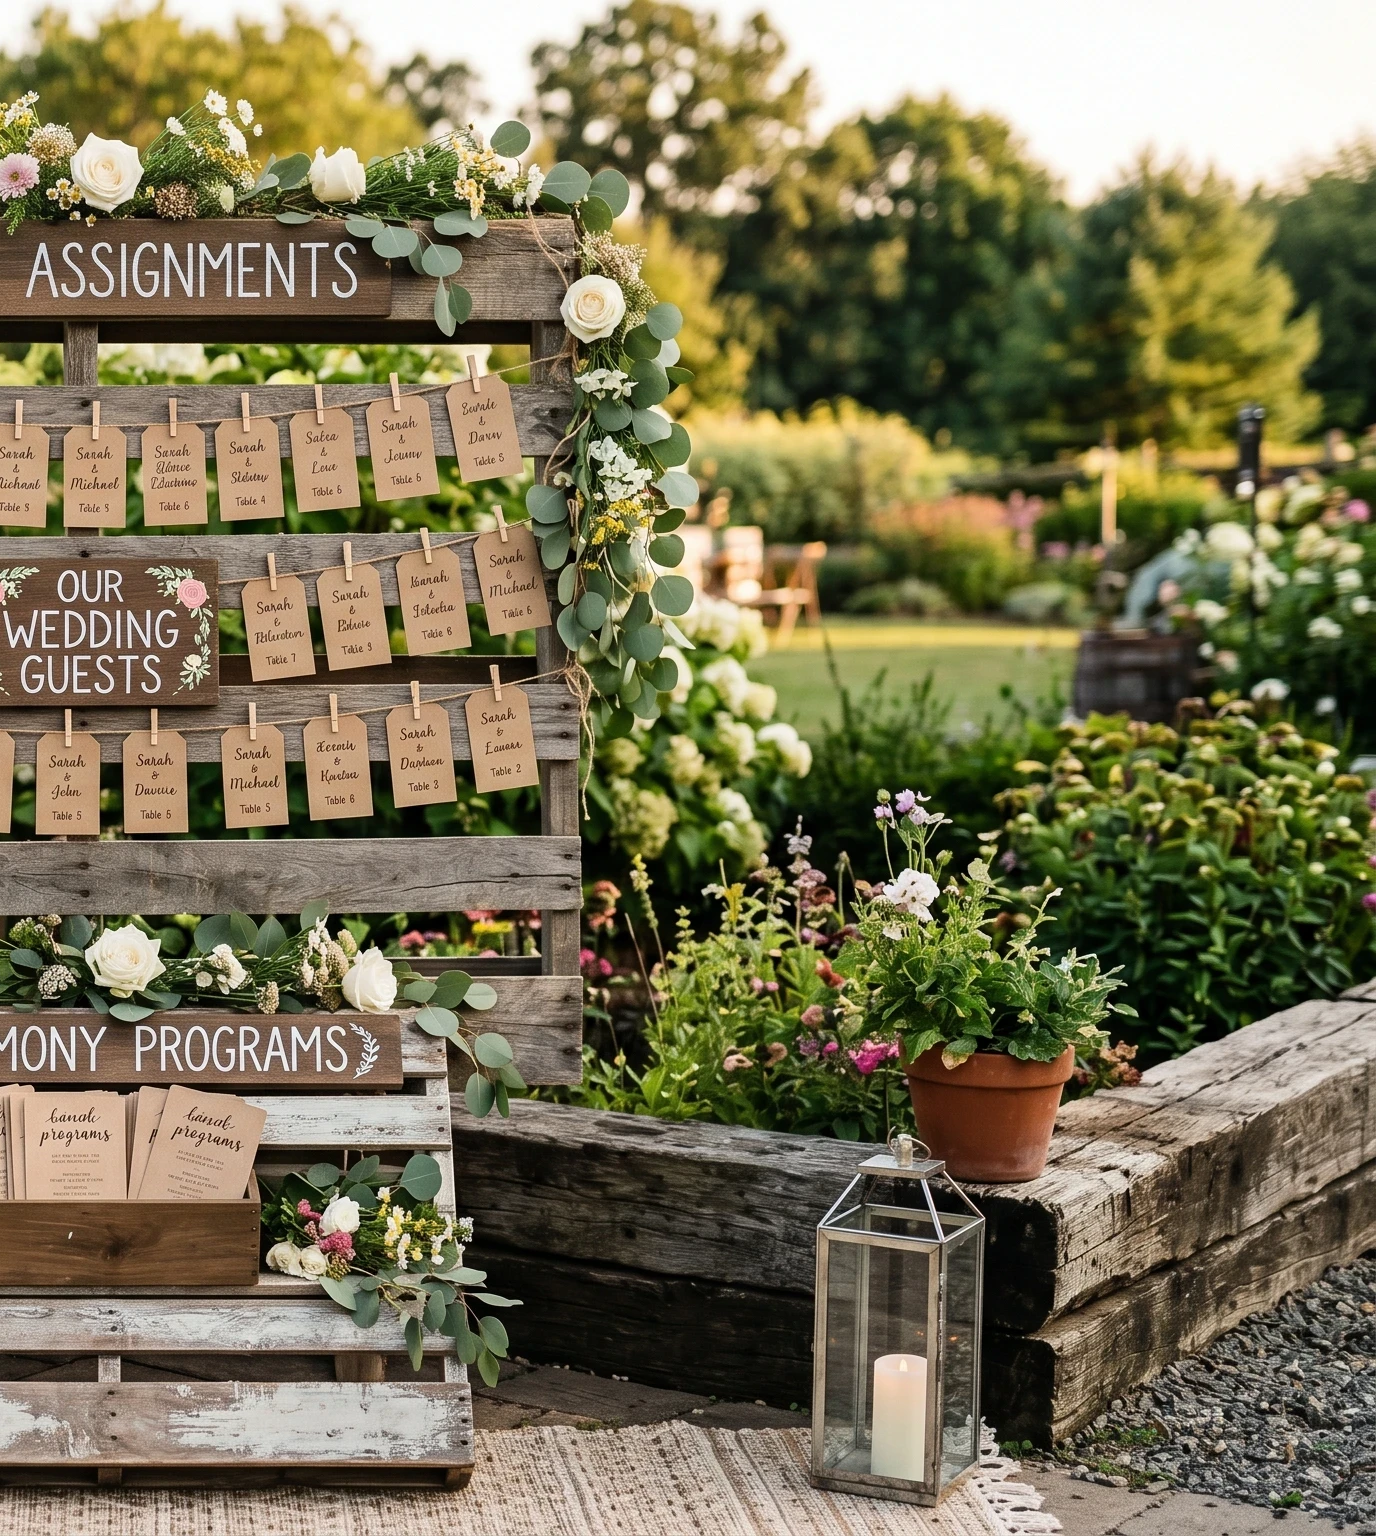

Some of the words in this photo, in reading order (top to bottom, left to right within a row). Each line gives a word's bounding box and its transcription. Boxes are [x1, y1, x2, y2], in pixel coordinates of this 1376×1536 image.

[26, 242, 357, 298] ASSIGNMENTS
[58, 570, 123, 602] OUR
[3, 610, 178, 648] WEDDING
[21, 655, 161, 693] GUESTS
[47, 753, 87, 769] Sarah
[134, 751, 174, 767] Sarah
[488, 765, 512, 778] Table
[515, 762, 522, 774] 2
[406, 780, 430, 792] Table
[348, 792, 355, 804] 6
[51, 810, 73, 821] Table
[75, 809, 82, 821] 5
[139, 808, 162, 820] Table
[264, 801, 271, 813] 5
[136, 1026, 347, 1072] PROGRAMS
